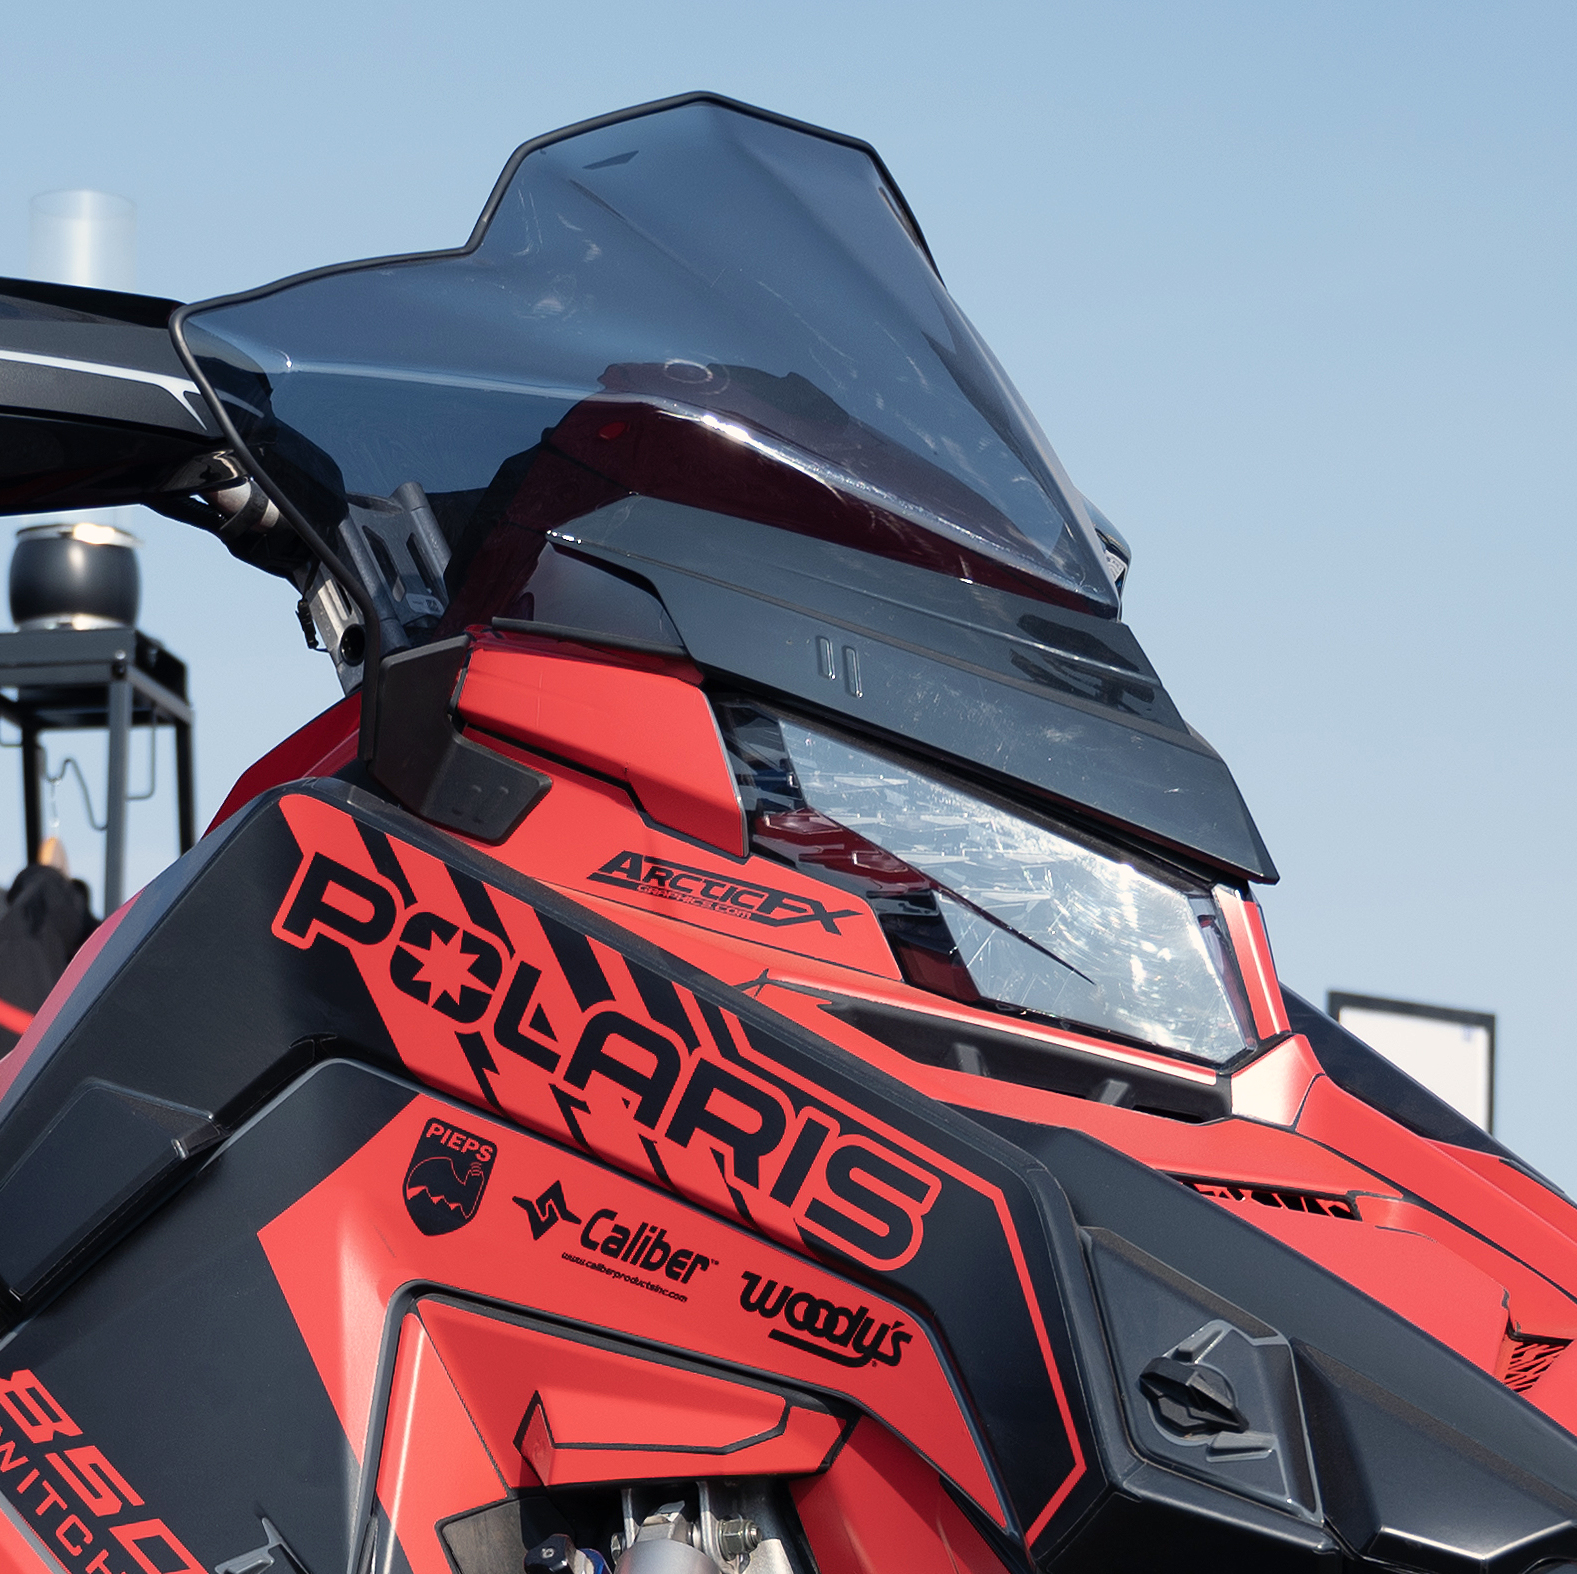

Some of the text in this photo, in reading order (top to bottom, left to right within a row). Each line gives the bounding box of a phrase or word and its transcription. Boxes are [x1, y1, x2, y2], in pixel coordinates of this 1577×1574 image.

[281, 852, 931, 1262] POLARIS
[425, 1122, 494, 1163] PIEPS
[561, 1251, 688, 1303] www.caliberproductsinc.com
